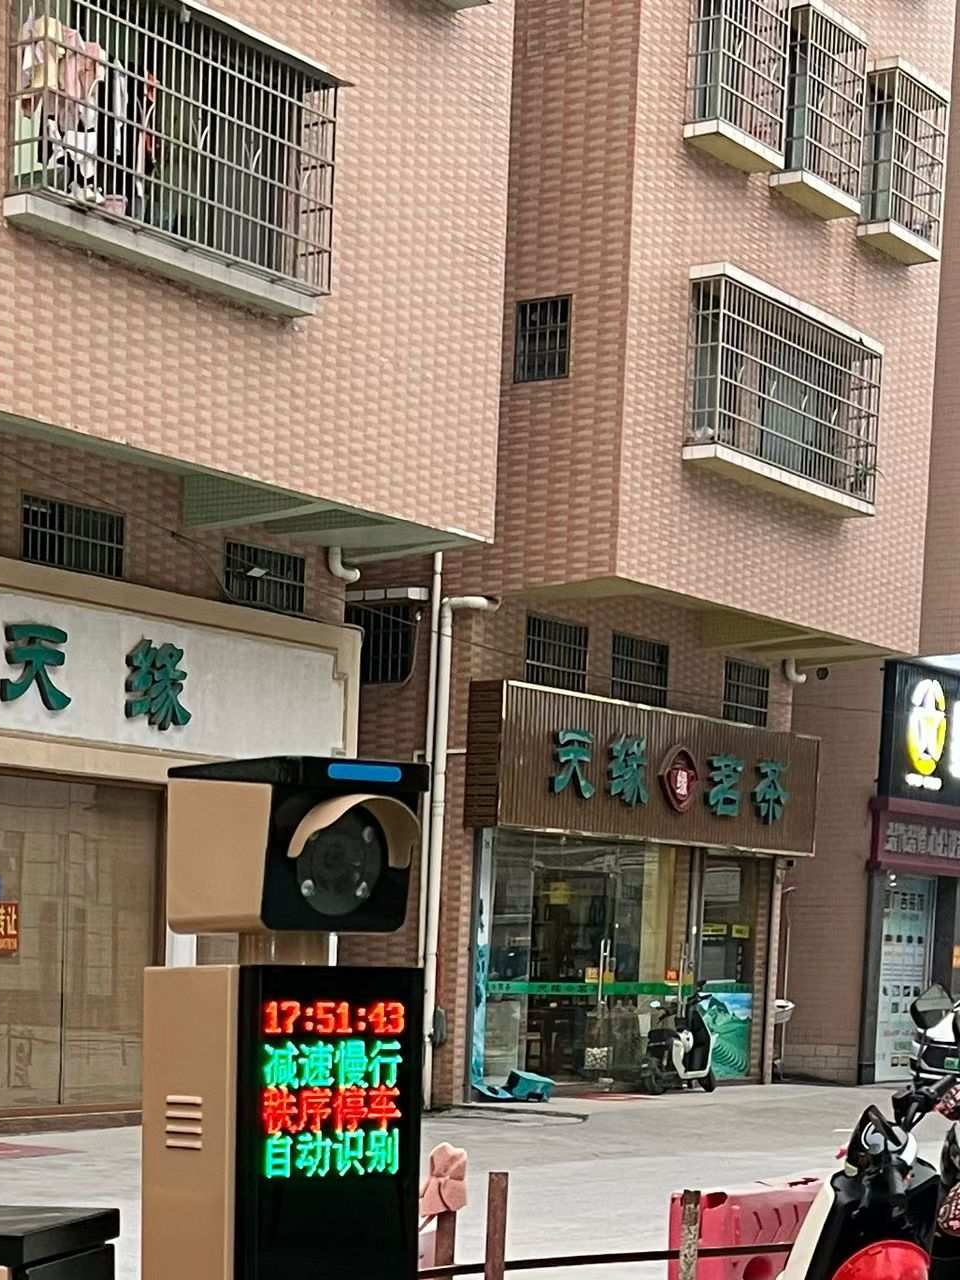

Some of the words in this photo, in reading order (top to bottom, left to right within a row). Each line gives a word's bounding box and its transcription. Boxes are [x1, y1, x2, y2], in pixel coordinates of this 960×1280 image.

[0, 622, 192, 731] 天缘
[551, 729, 649, 808] 天缘
[264, 1001, 405, 1034] 17:51:43
[263, 1040, 403, 1089] 减速慢行
[262, 1085, 402, 1134] 秩序停车
[264, 1128, 400, 1179] 自动识别
